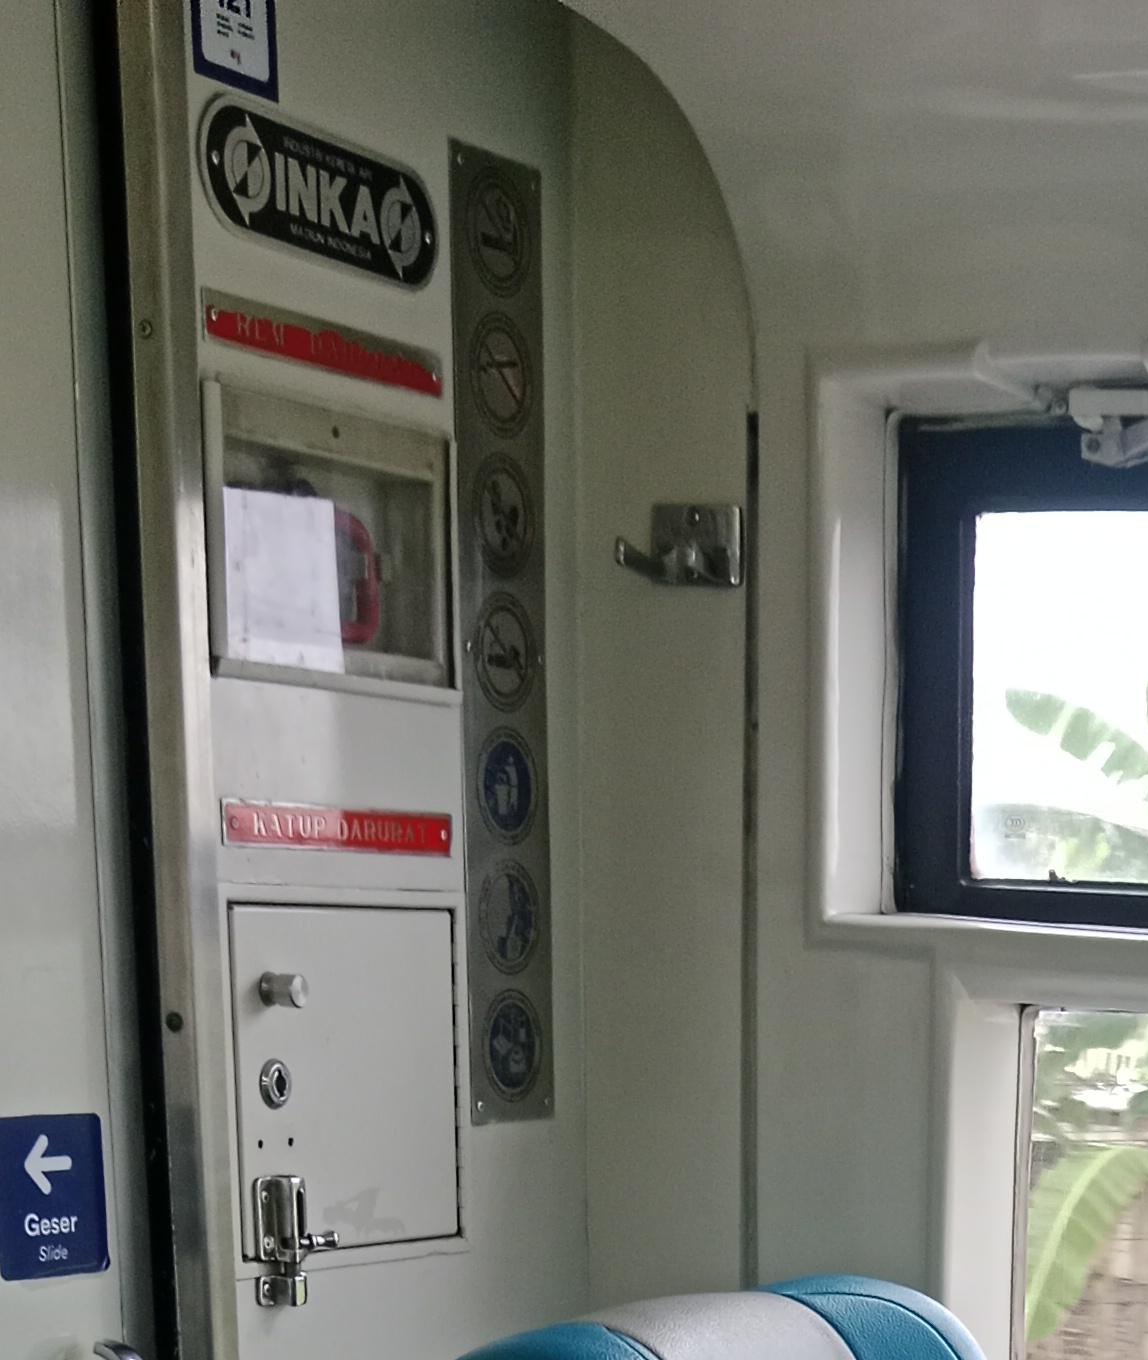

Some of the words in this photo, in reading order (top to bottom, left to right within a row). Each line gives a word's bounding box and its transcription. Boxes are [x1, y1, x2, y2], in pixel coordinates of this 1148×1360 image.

[274, 152, 381, 246] INKA
[252, 812, 327, 839] KATUP
[336, 818, 428, 844] DARURAT
[24, 1213, 78, 1237] Geser
[38, 1243, 69, 1263] Slide
